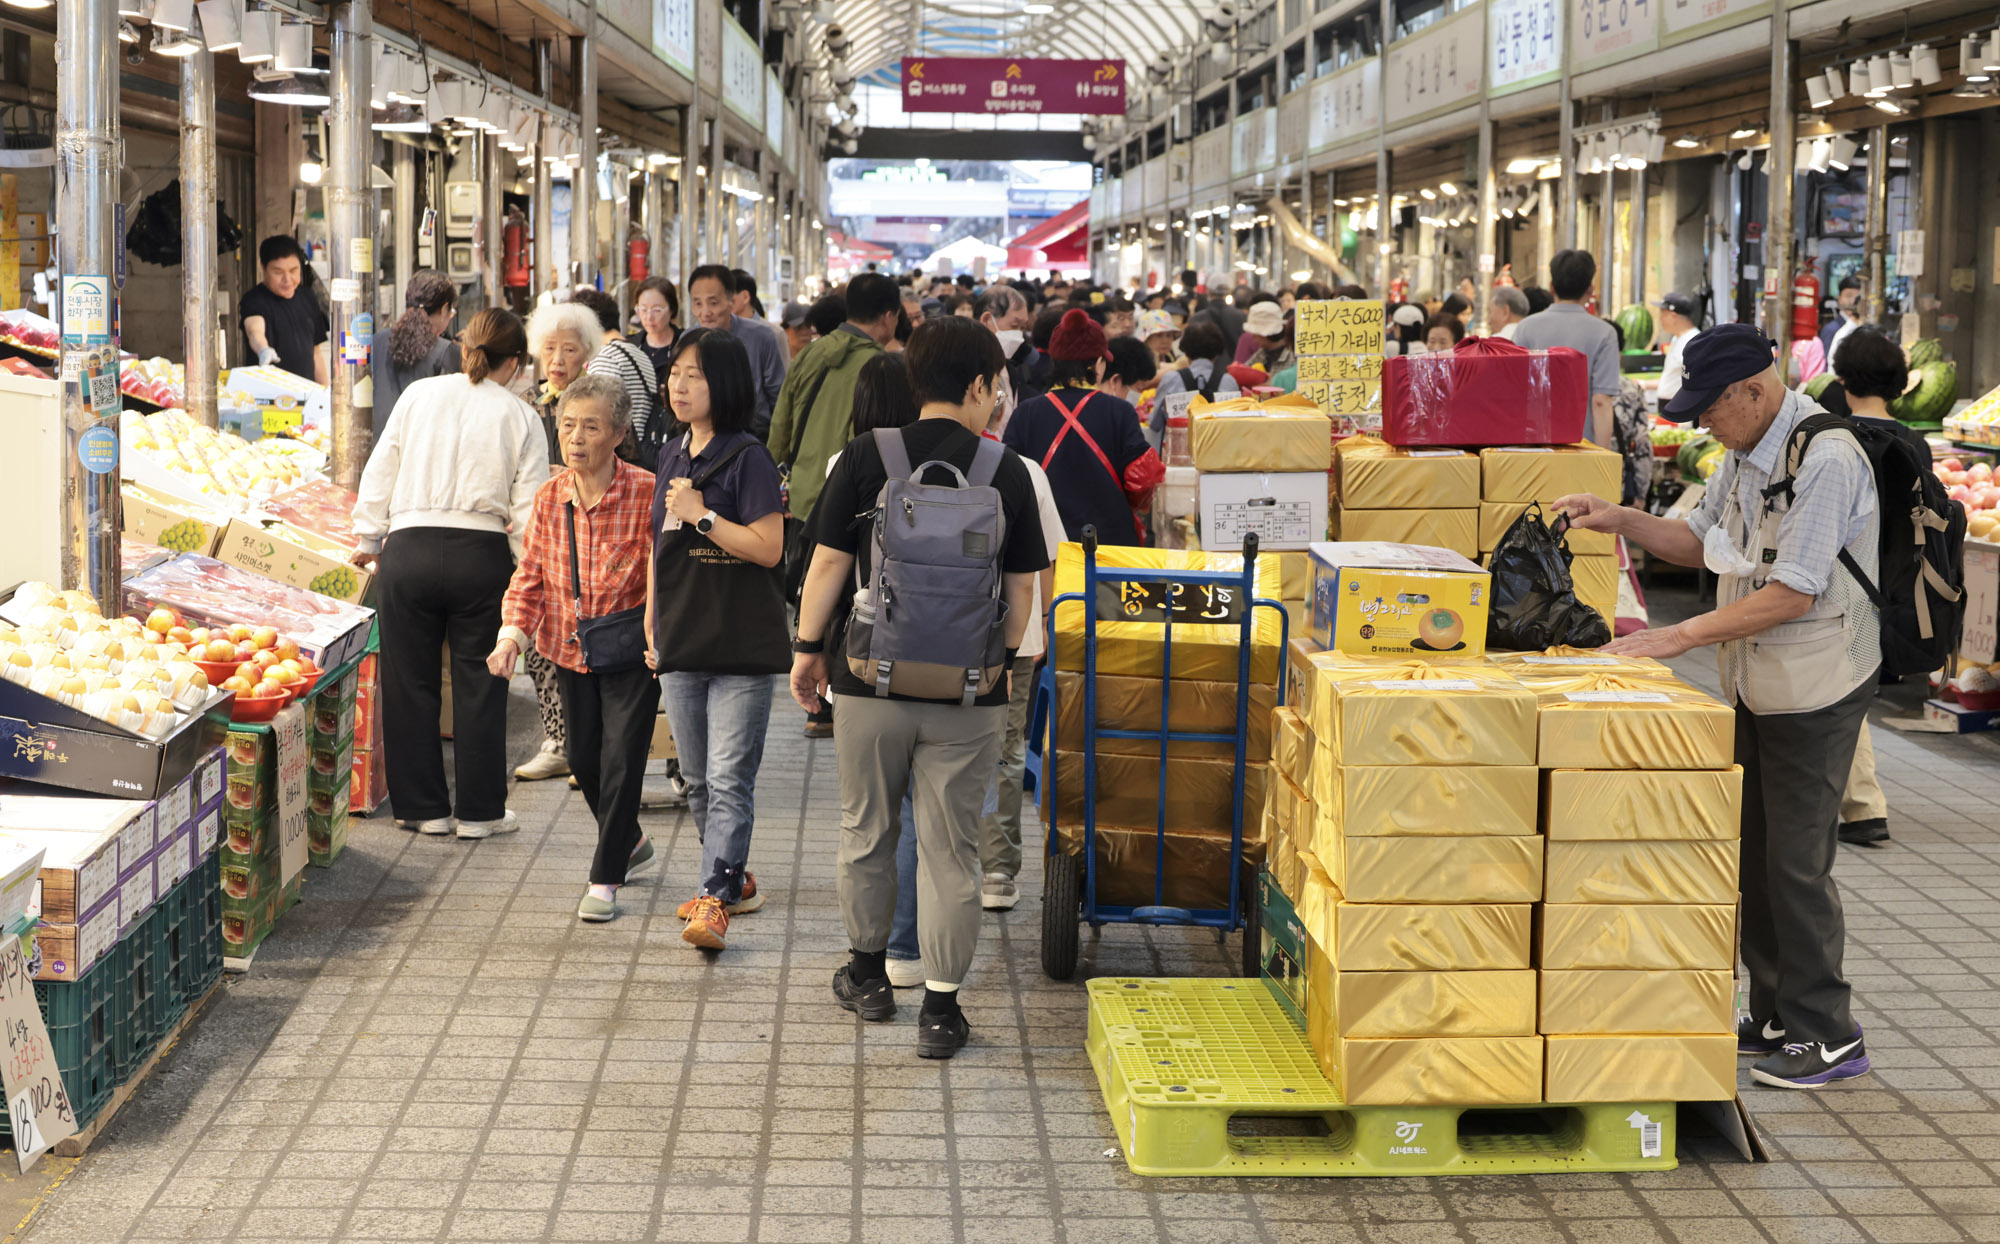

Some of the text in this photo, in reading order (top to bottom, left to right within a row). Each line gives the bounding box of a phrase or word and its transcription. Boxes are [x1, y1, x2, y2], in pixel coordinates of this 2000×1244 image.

[1010, 84, 1036, 95] 주차장
[1092, 85, 1119, 96] 화장실
[1297, 330, 1381, 354] 꼴뚜기 가리비
[1361, 627, 1374, 639] 단감
[1389, 1146, 1428, 1155] AJ네트웍스
